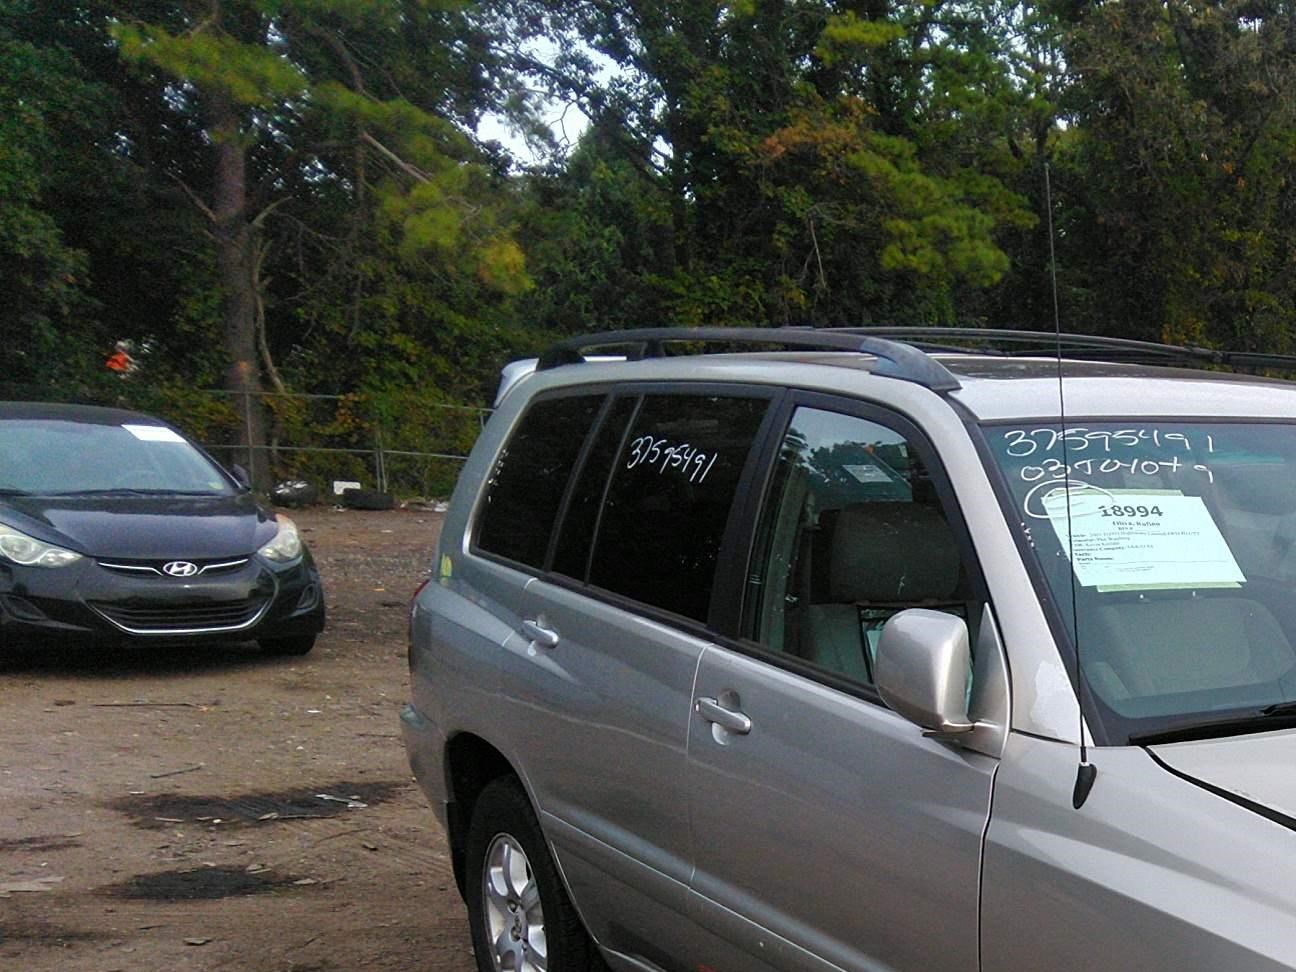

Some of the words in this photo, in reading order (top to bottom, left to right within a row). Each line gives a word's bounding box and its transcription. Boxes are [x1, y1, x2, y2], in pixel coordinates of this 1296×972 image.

[1004, 428, 1214, 457] 37595491
[627, 436, 718, 483] 37595491
[1098, 504, 1163, 517] 18994
